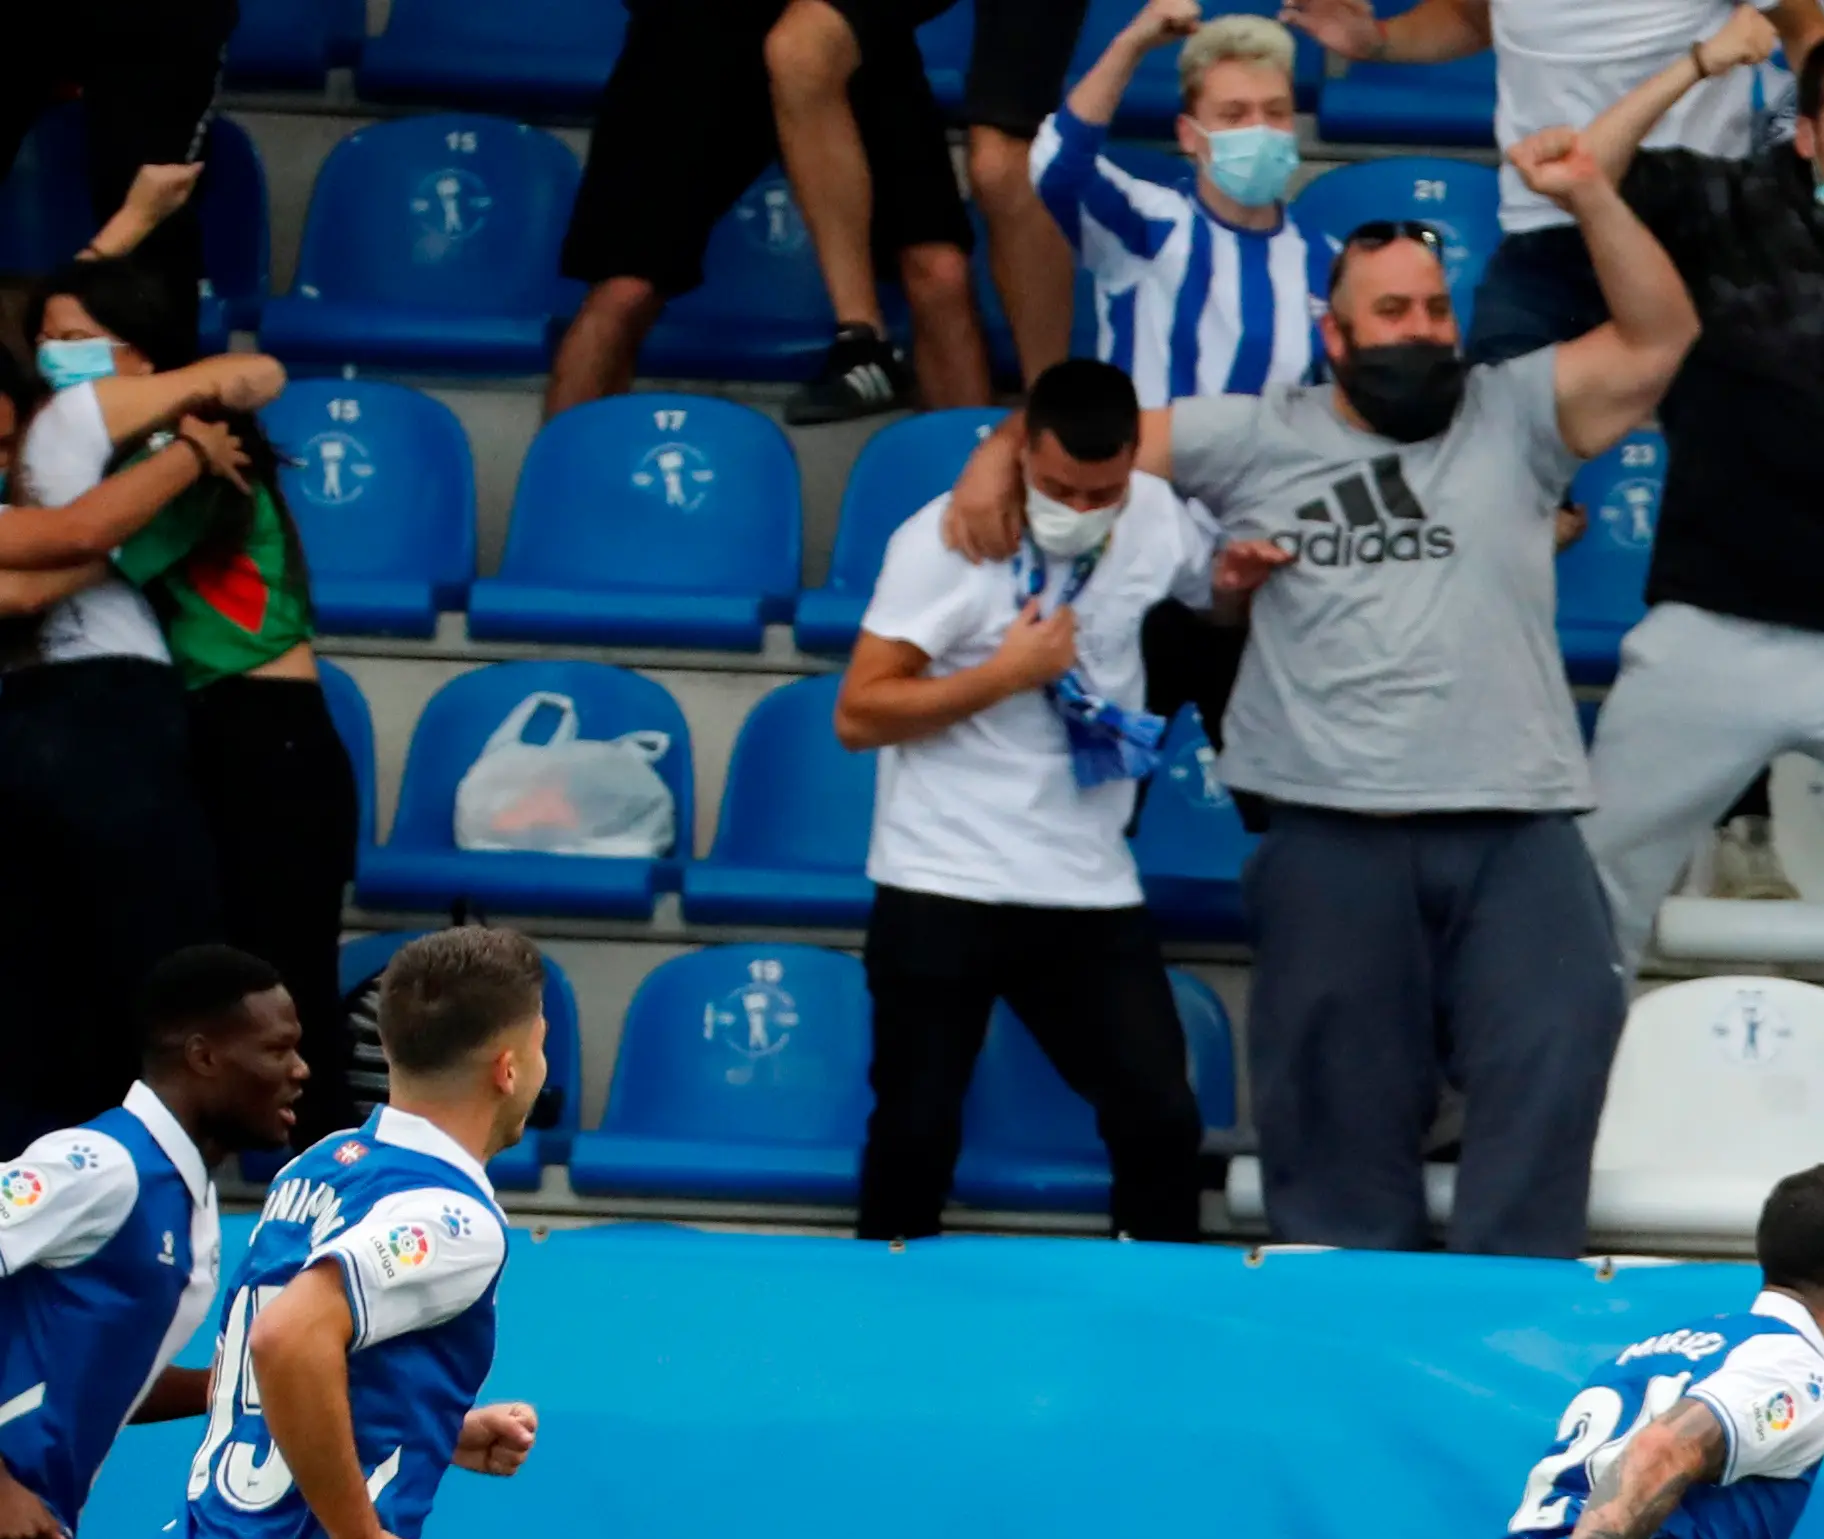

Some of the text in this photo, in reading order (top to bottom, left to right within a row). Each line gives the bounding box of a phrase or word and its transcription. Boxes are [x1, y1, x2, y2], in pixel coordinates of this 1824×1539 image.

[653, 409, 686, 431] 17
[1621, 444, 1657, 466] 23
[1270, 519, 1455, 567] adidas
